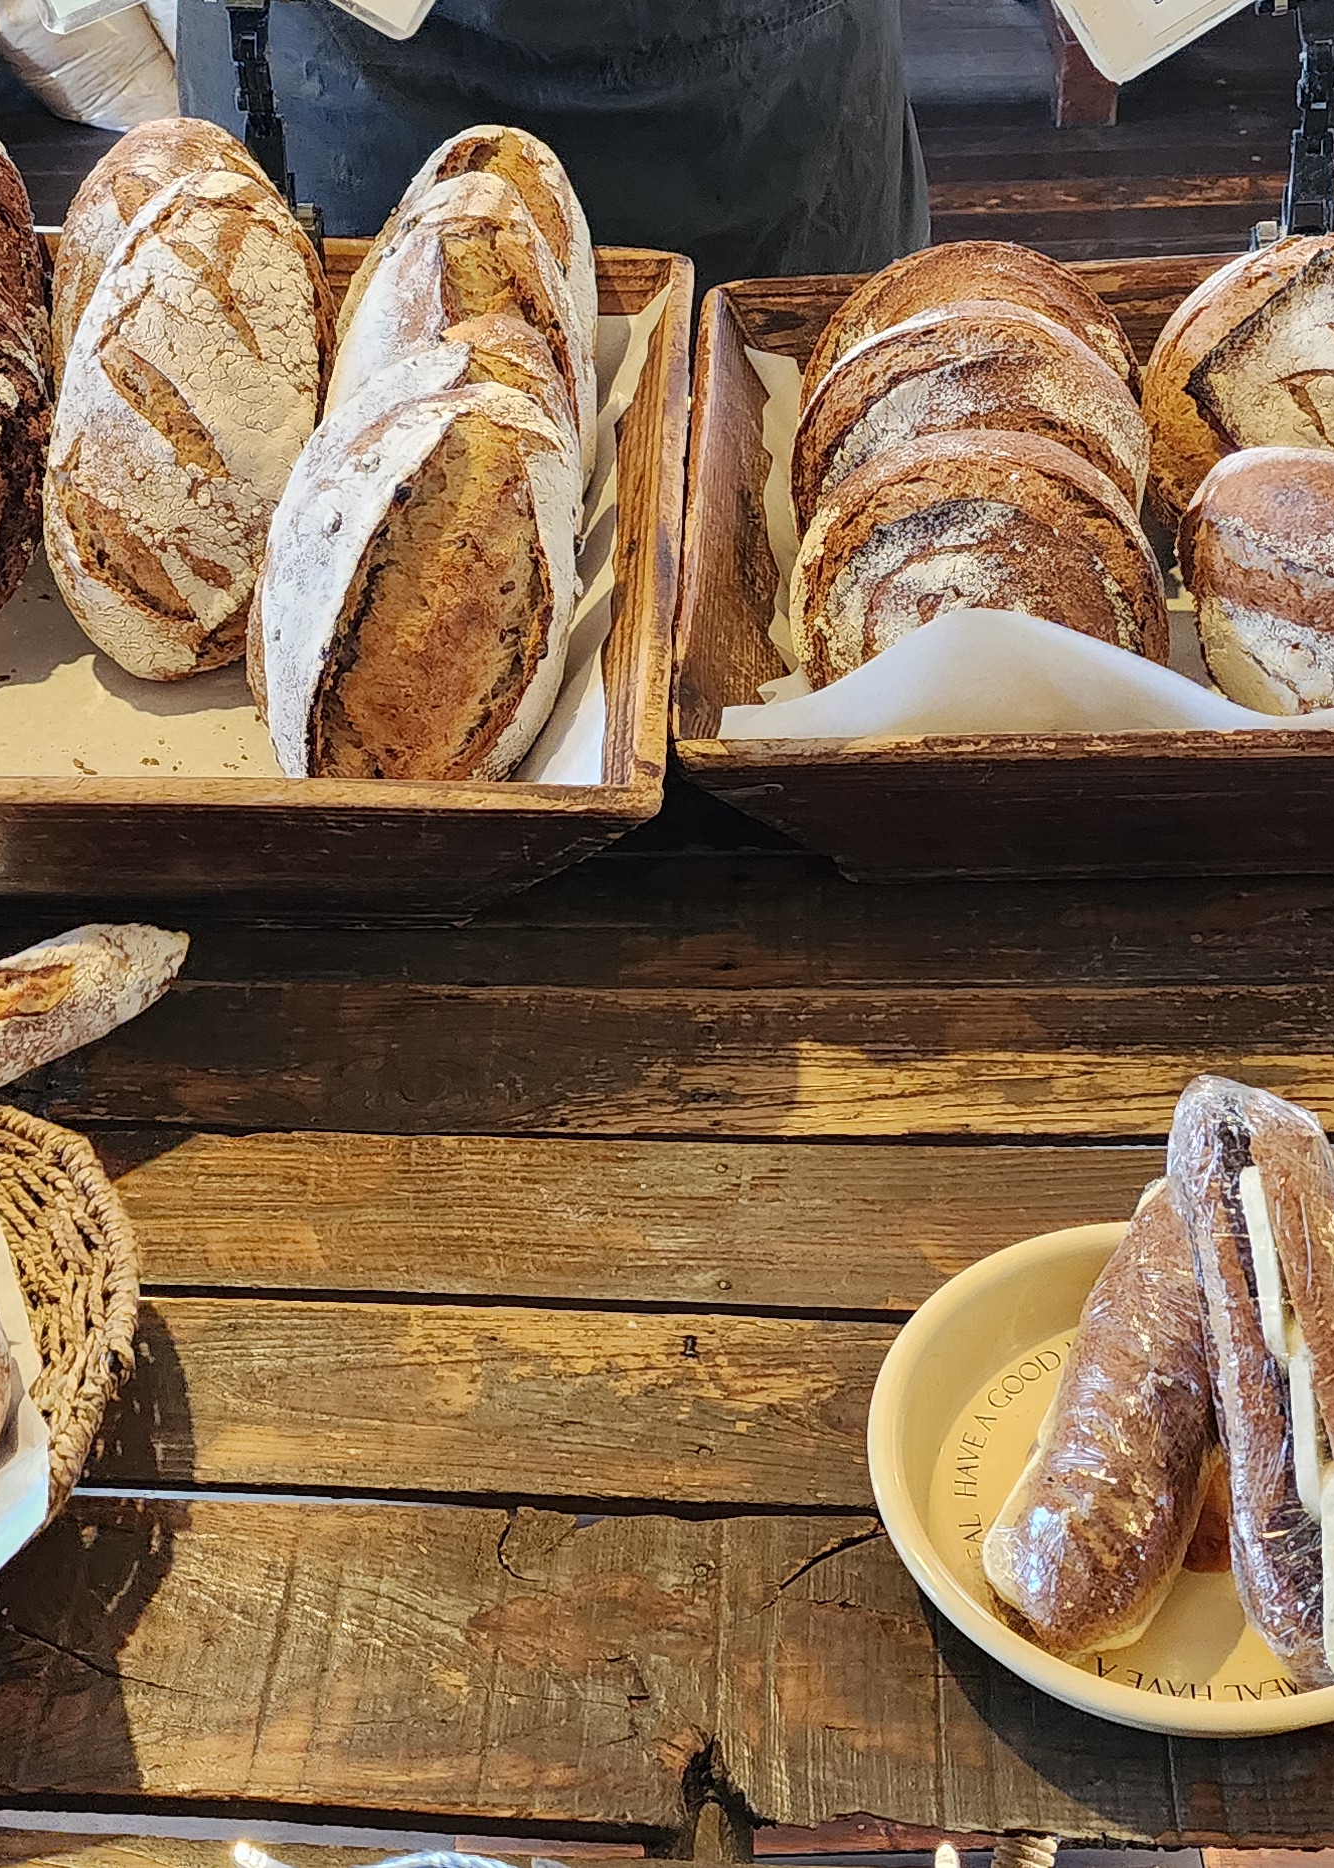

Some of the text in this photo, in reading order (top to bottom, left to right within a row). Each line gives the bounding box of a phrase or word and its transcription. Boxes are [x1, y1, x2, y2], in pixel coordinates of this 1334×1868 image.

[953, 1431, 988, 1498] HAVE
[973, 1413, 998, 1432] A
[987, 1350, 1062, 1409] GOOD
[1126, 1668, 1213, 1702] HAVE
